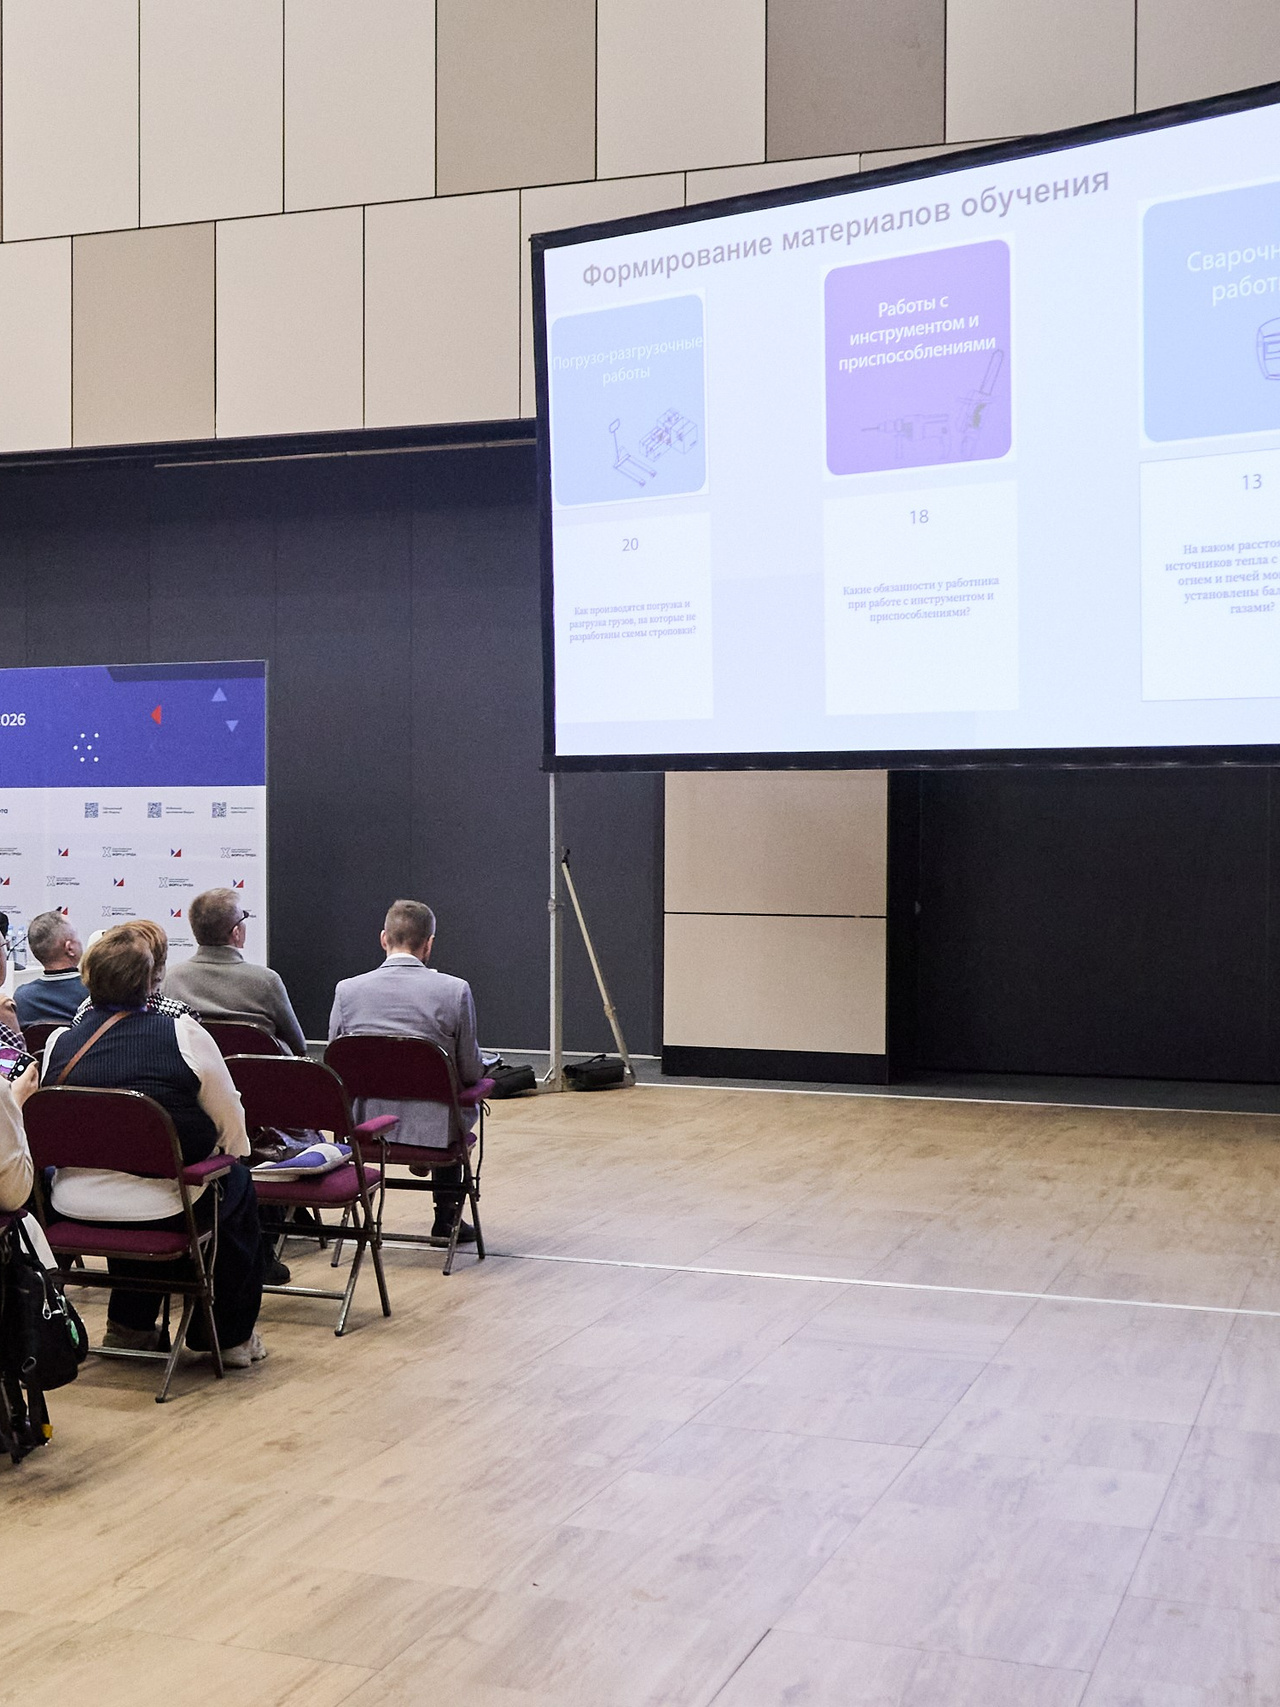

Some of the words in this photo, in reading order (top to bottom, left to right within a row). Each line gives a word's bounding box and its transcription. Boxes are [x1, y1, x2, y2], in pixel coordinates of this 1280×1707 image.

[583, 236, 772, 287] Формирование
[782, 202, 950, 250] материалов
[961, 171, 1109, 217] обучения
[1212, 275, 1280, 306] работ
[878, 296, 936, 317] Работы
[940, 296, 949, 308] с
[850, 317, 965, 346] инструментом
[969, 315, 980, 328] и
[553, 335, 703, 371] Погрузо-разгрузочные
[839, 337, 996, 373] приспособлениями
[602, 365, 651, 387] работы
[1242, 474, 1263, 490] 13
[910, 509, 929, 524] 18
[622, 537, 639, 552] 20
[1183, 544, 1198, 554] На
[1201, 542, 1234, 553] каком
[1165, 558, 1232, 571] источников
[1235, 556, 1268, 566] тепла
[843, 585, 872, 595] Какие
[873, 581, 936, 594] обязанности
[937, 582, 943, 591] у
[945, 577, 999, 591] работника
[1178, 576, 1212, 586] огнем
[1215, 575, 1222, 584] и
[1225, 570, 1259, 583] печей
[1262, 571, 1280, 580] мо
[848, 600, 867, 611] при
[868, 596, 902, 610] работе
[903, 598, 909, 606] с
[910, 592, 985, 606] инструментом
[987, 592, 994, 601] и
[1184, 588, 1259, 604] установлены
[574, 606, 588, 616] Как
[590, 603, 645, 616] производятся
[646, 600, 682, 612] погрузка
[685, 600, 691, 608] и
[870, 606, 971, 624] приспособлениями?
[1230, 602, 1275, 614] газами?
[638, 616, 648, 625] на
[649, 614, 684, 625] которые
[686, 613, 696, 621] не
[569, 630, 620, 644] разработаны
[621, 629, 647, 638] схемы
